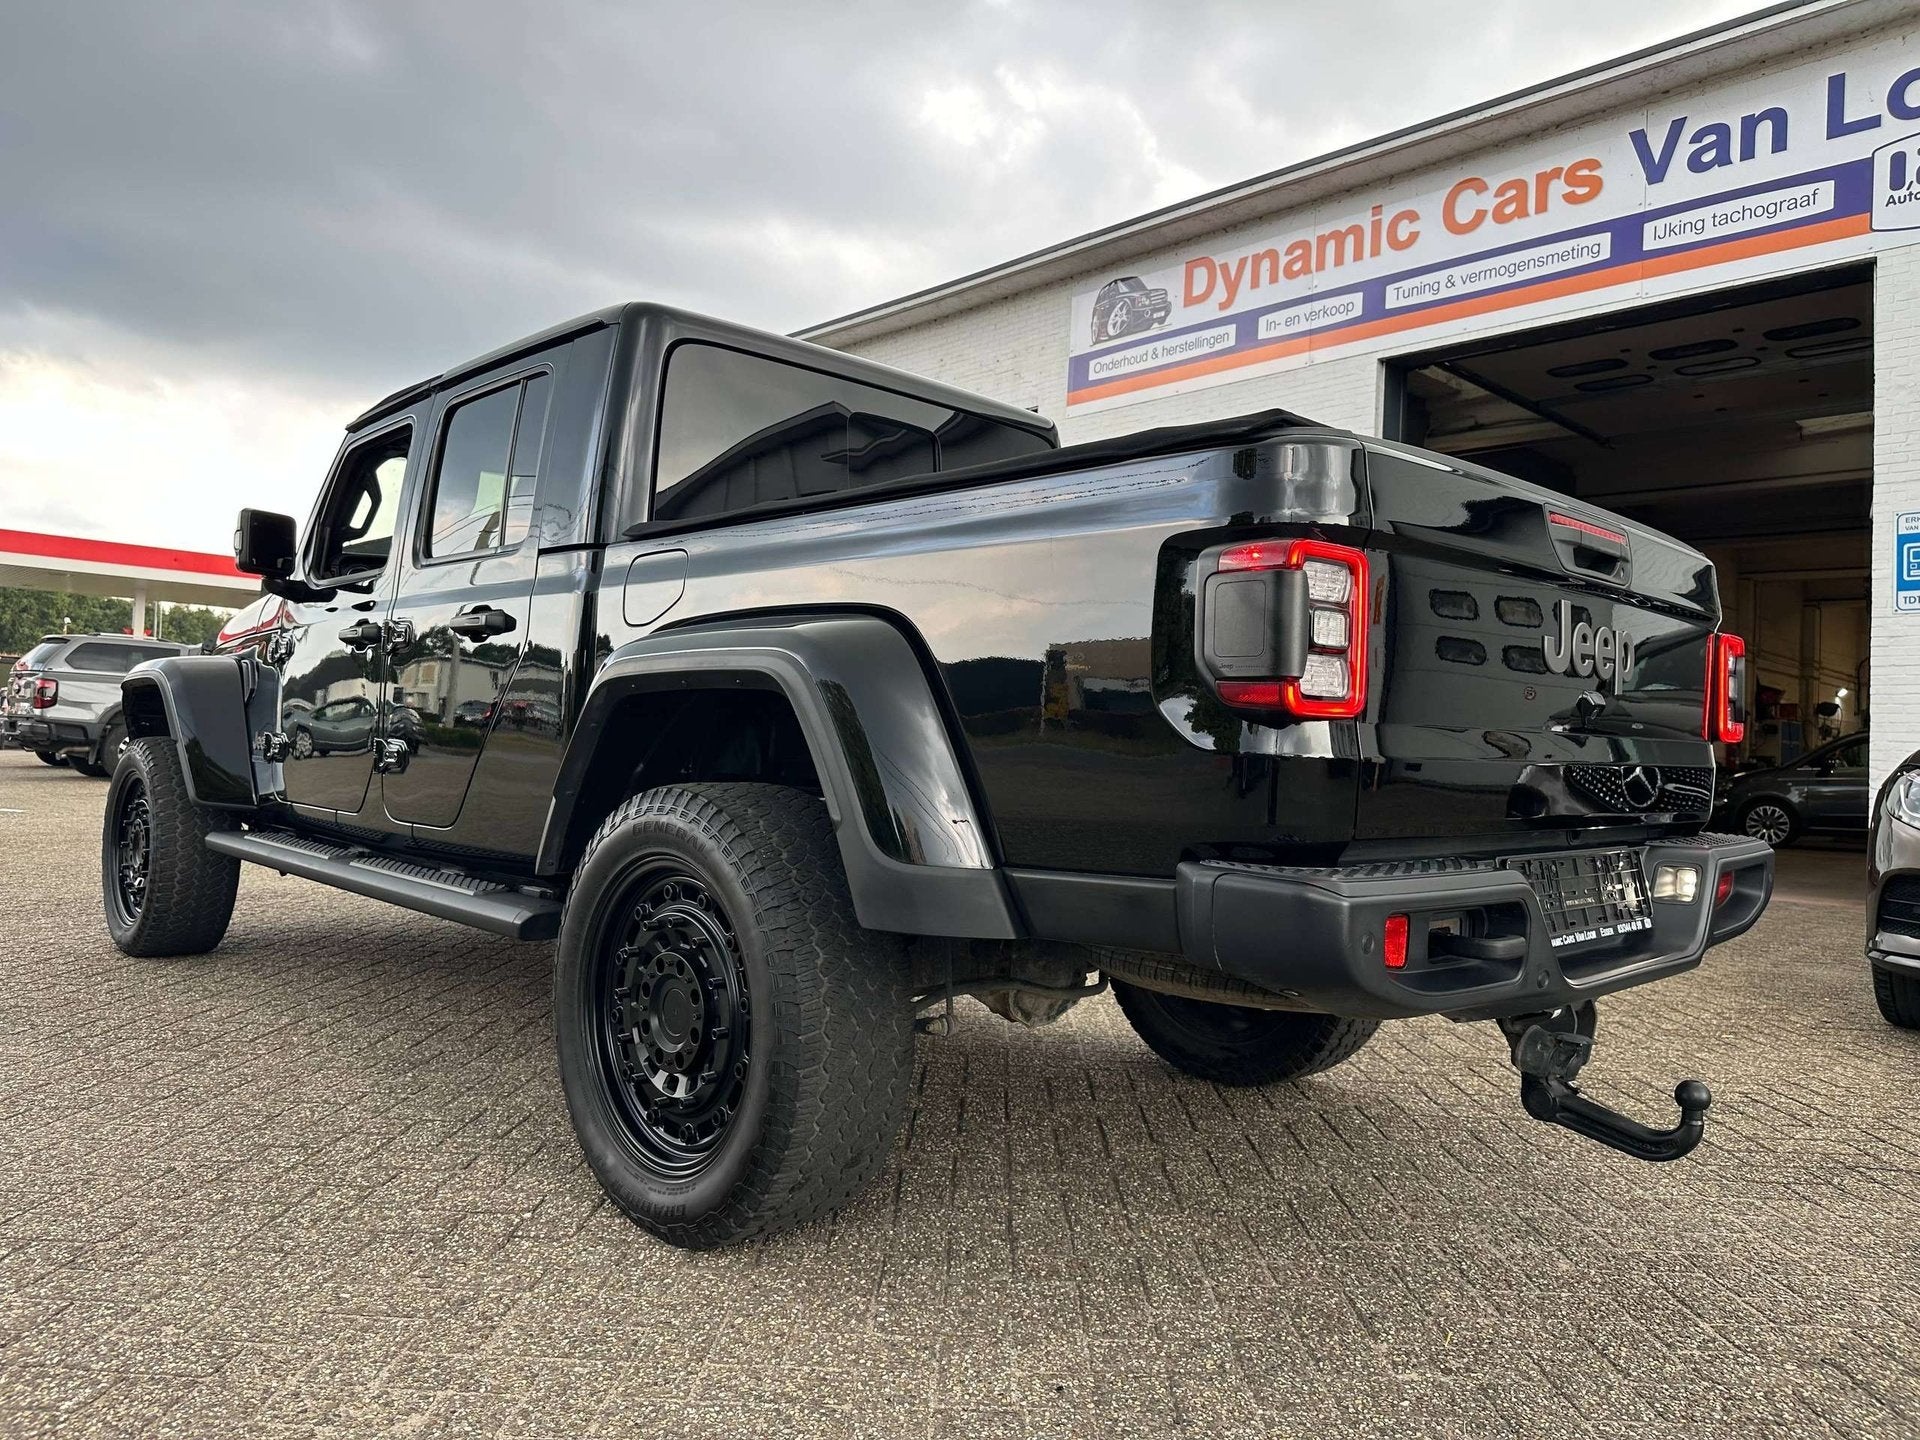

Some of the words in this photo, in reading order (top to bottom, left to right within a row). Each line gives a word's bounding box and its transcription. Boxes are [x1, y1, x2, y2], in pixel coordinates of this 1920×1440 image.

[1183, 205, 1420, 311] Dynamic
[1442, 157, 1604, 235] Cars
[1628, 106, 1788, 186] Van
[1653, 215, 1705, 242] IJking
[1711, 188, 1819, 229] tachograaf
[1394, 280, 1440, 301] Tuning
[1445, 274, 1456, 289] &
[1460, 242, 1601, 286] vermogensmeting
[1266, 319, 1281, 332] In-
[1284, 314, 1300, 327] en
[1304, 301, 1354, 322] verkoop
[1093, 350, 1148, 374] Onderhoud
[1151, 347, 1159, 360] &
[1162, 331, 1229, 357] herstellingen
[1543, 600, 1634, 695] Jeep
